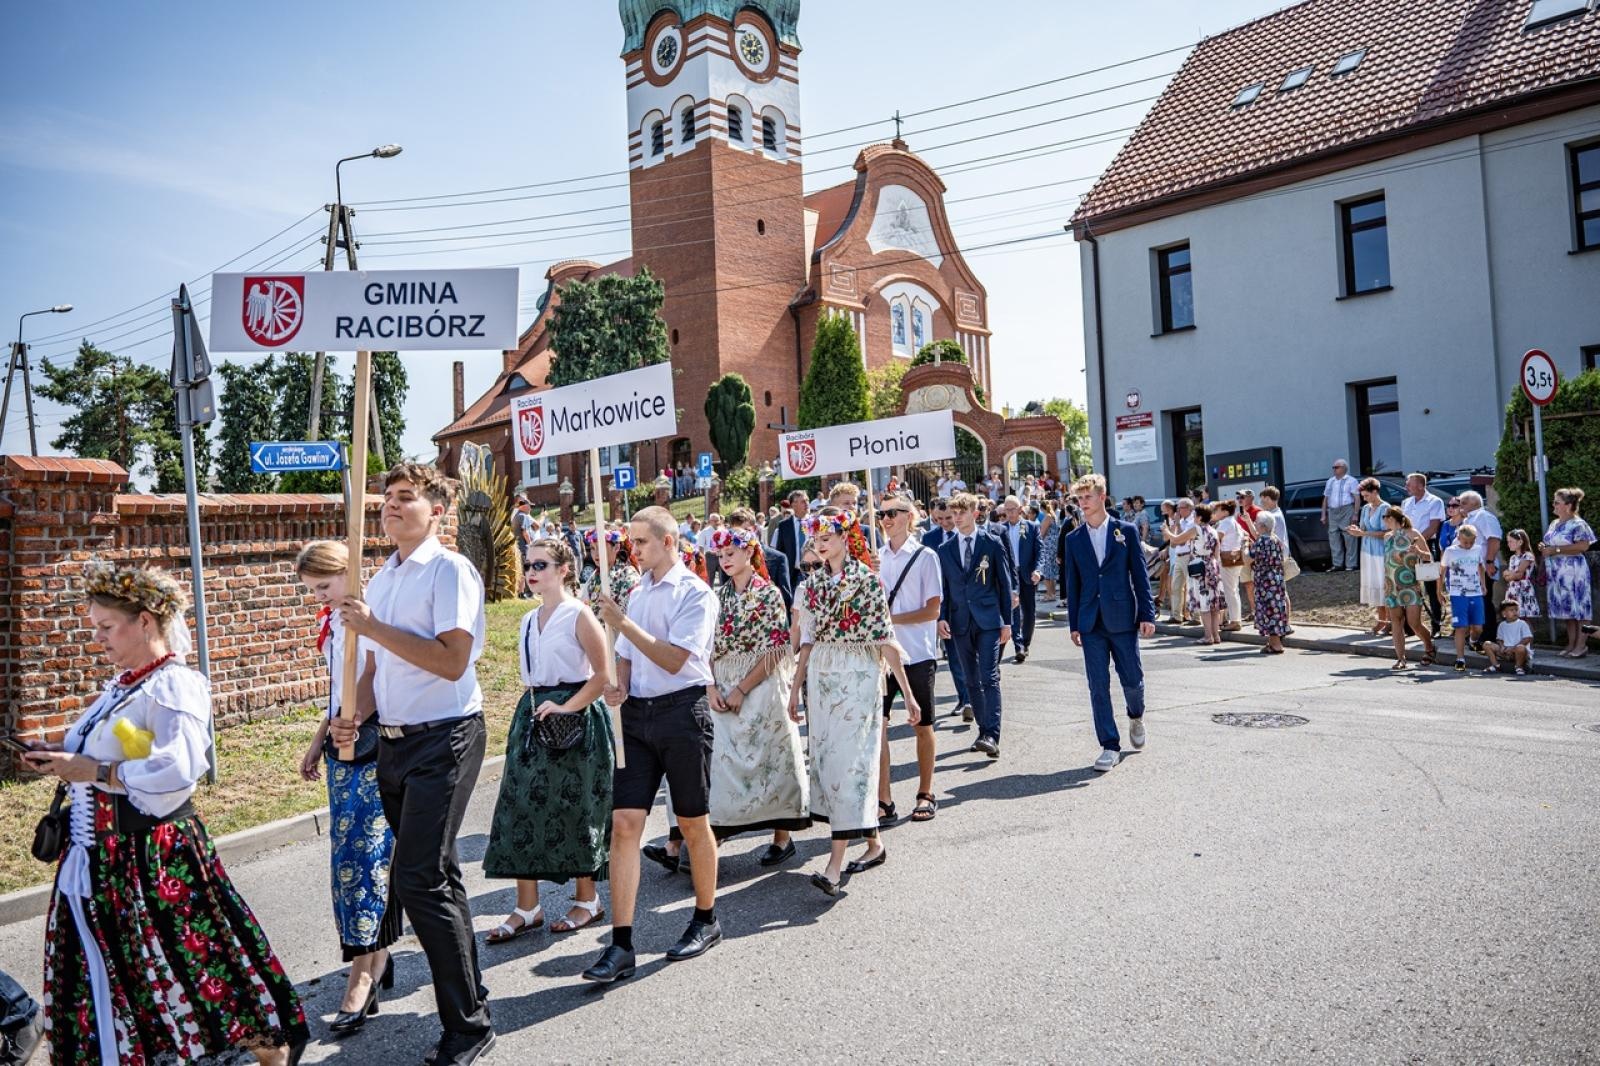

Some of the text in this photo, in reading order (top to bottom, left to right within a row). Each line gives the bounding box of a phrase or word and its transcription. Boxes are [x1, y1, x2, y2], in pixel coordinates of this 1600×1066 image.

[363, 281, 459, 305] GMINA
[335, 309, 485, 339] RACIBÓRZ
[1527, 365, 1553, 389] 3,5t
[517, 397, 542, 407] Racibórz
[551, 391, 666, 436] Markowice
[786, 433, 815, 441] Racibórz
[849, 430, 920, 457] Płonia
[264, 452, 275, 466] ul.
[276, 451, 300, 466] Józefa
[701, 455, 710, 471] P
[618, 469, 631, 487] P
